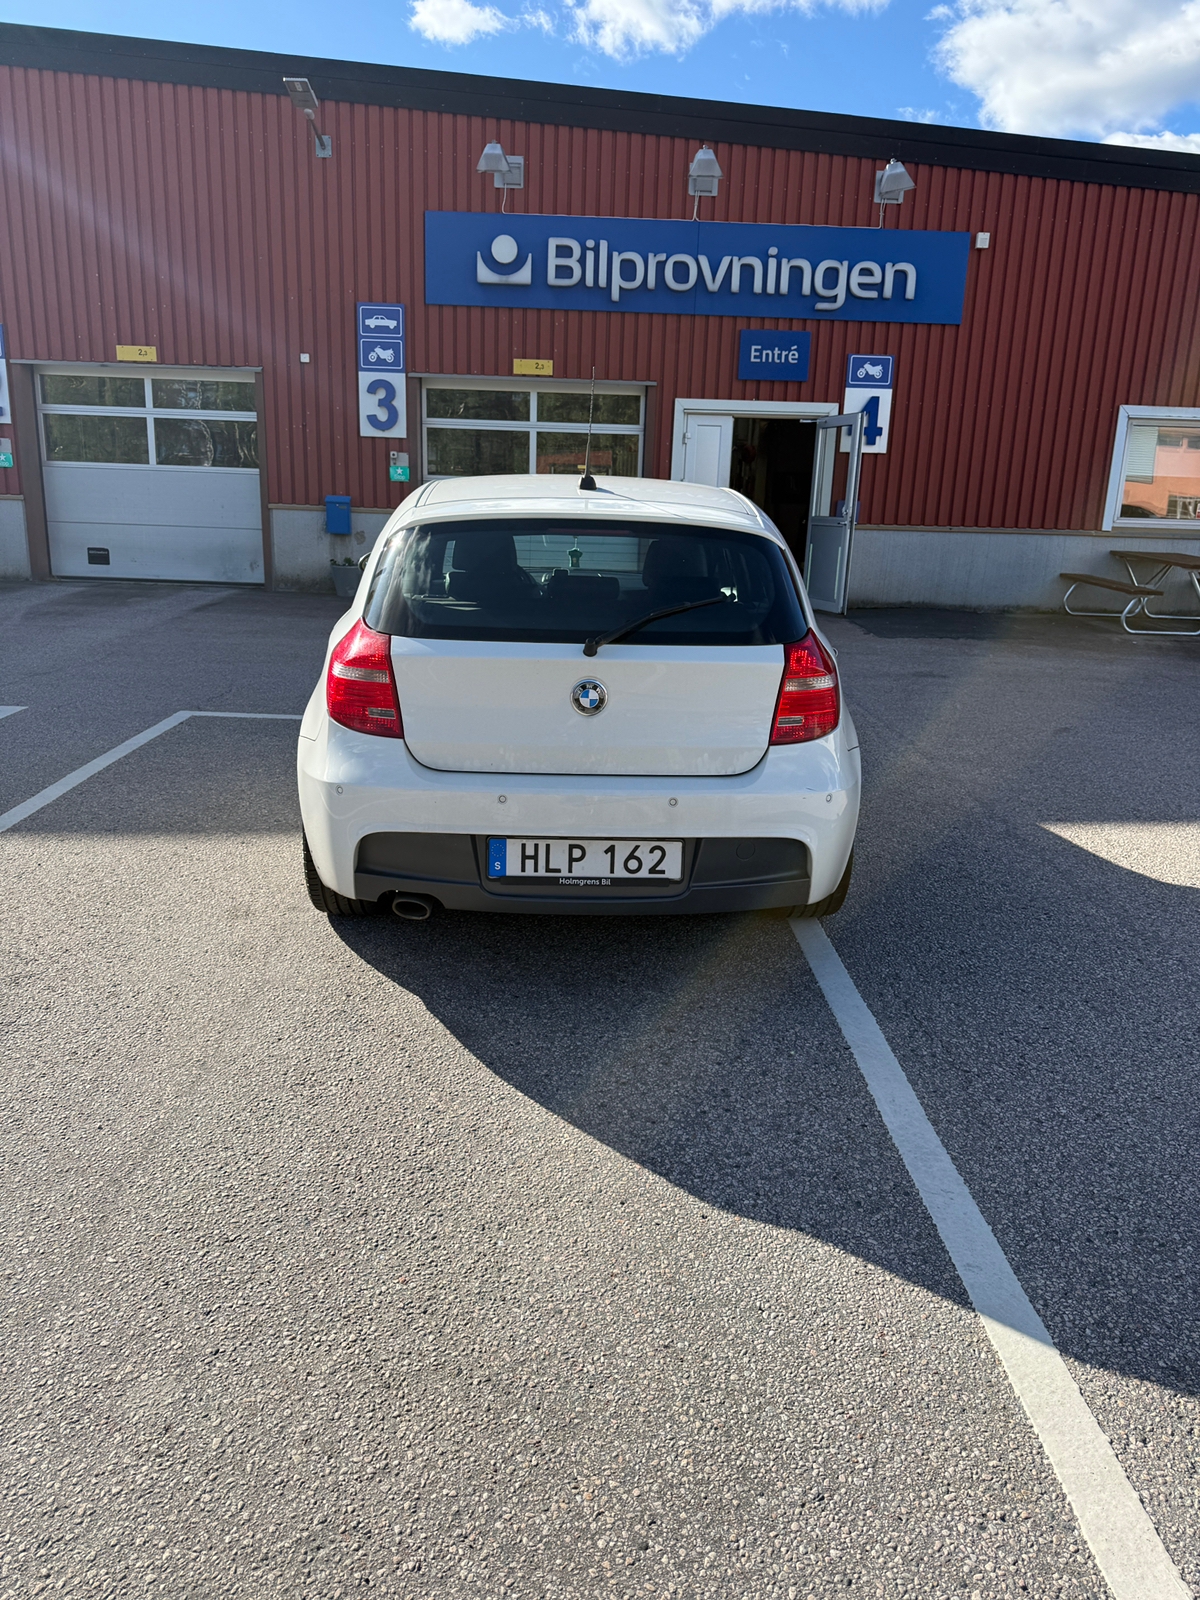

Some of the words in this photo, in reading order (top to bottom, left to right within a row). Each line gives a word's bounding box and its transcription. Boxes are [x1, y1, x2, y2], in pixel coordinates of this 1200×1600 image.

[547, 236, 917, 311] Bilprovningen
[750, 345, 799, 364] Entré
[366, 378, 399, 431] 3
[847, 396, 883, 446] 4
[494, 861, 501, 871] S
[520, 843, 587, 874] HLP
[603, 844, 667, 875] 162
[559, 877, 600, 886] Holmgrens
[601, 878, 611, 886] Bil
